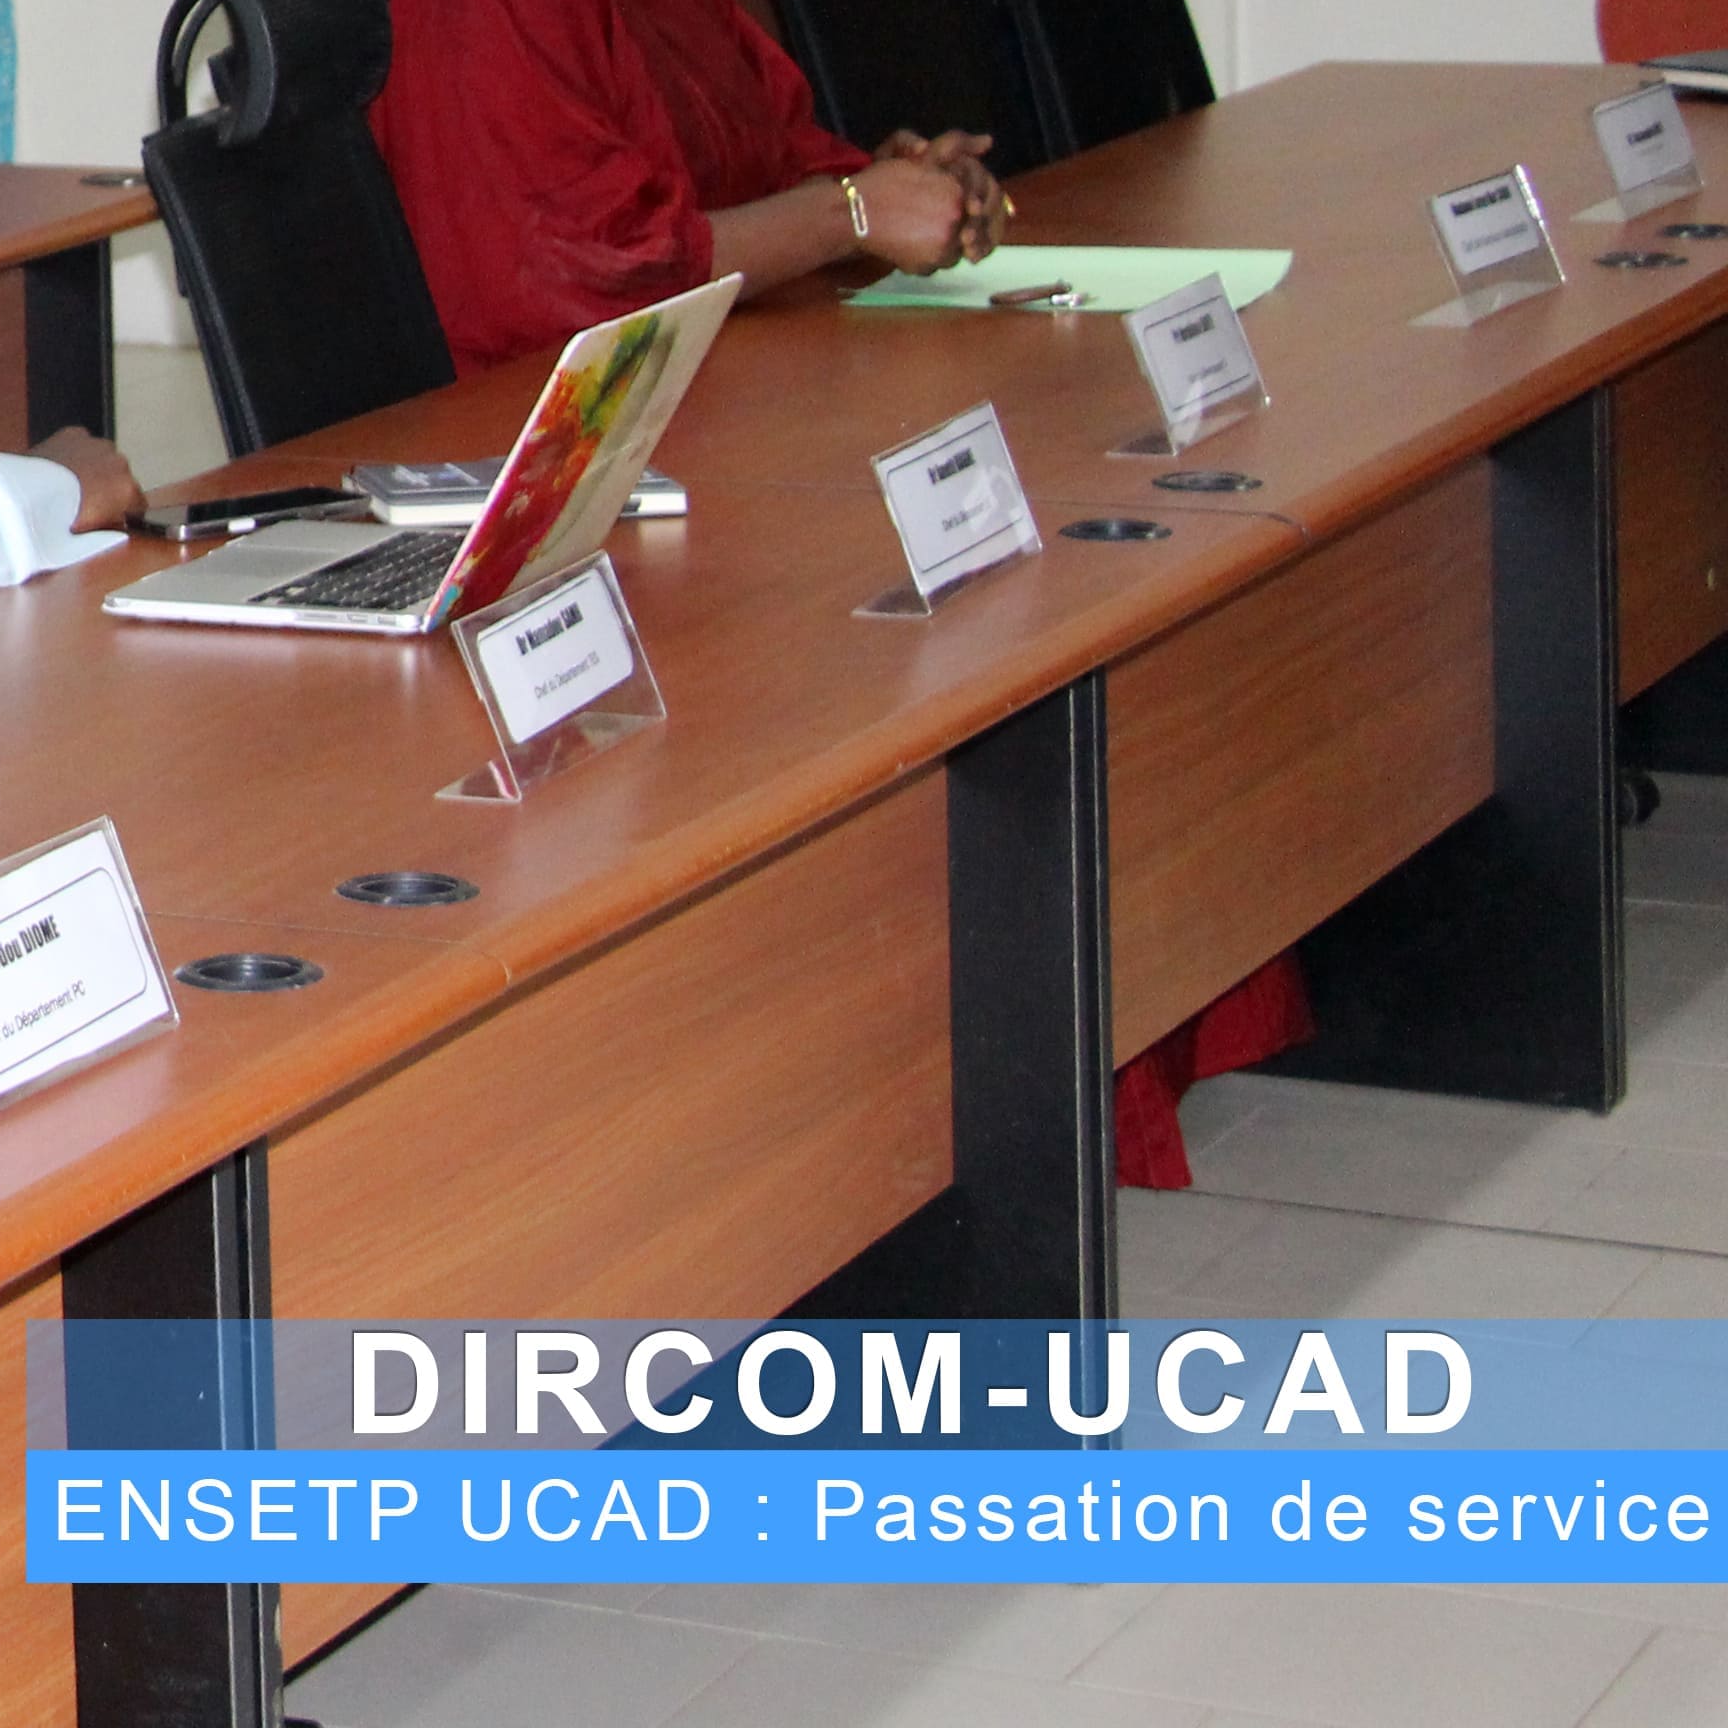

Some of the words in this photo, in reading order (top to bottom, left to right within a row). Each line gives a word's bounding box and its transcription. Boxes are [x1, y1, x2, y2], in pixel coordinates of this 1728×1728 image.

[19, 915, 60, 955] DIOME
[2, 1019, 14, 1038] du
[15, 989, 72, 1030] Département
[72, 980, 85, 999] PC
